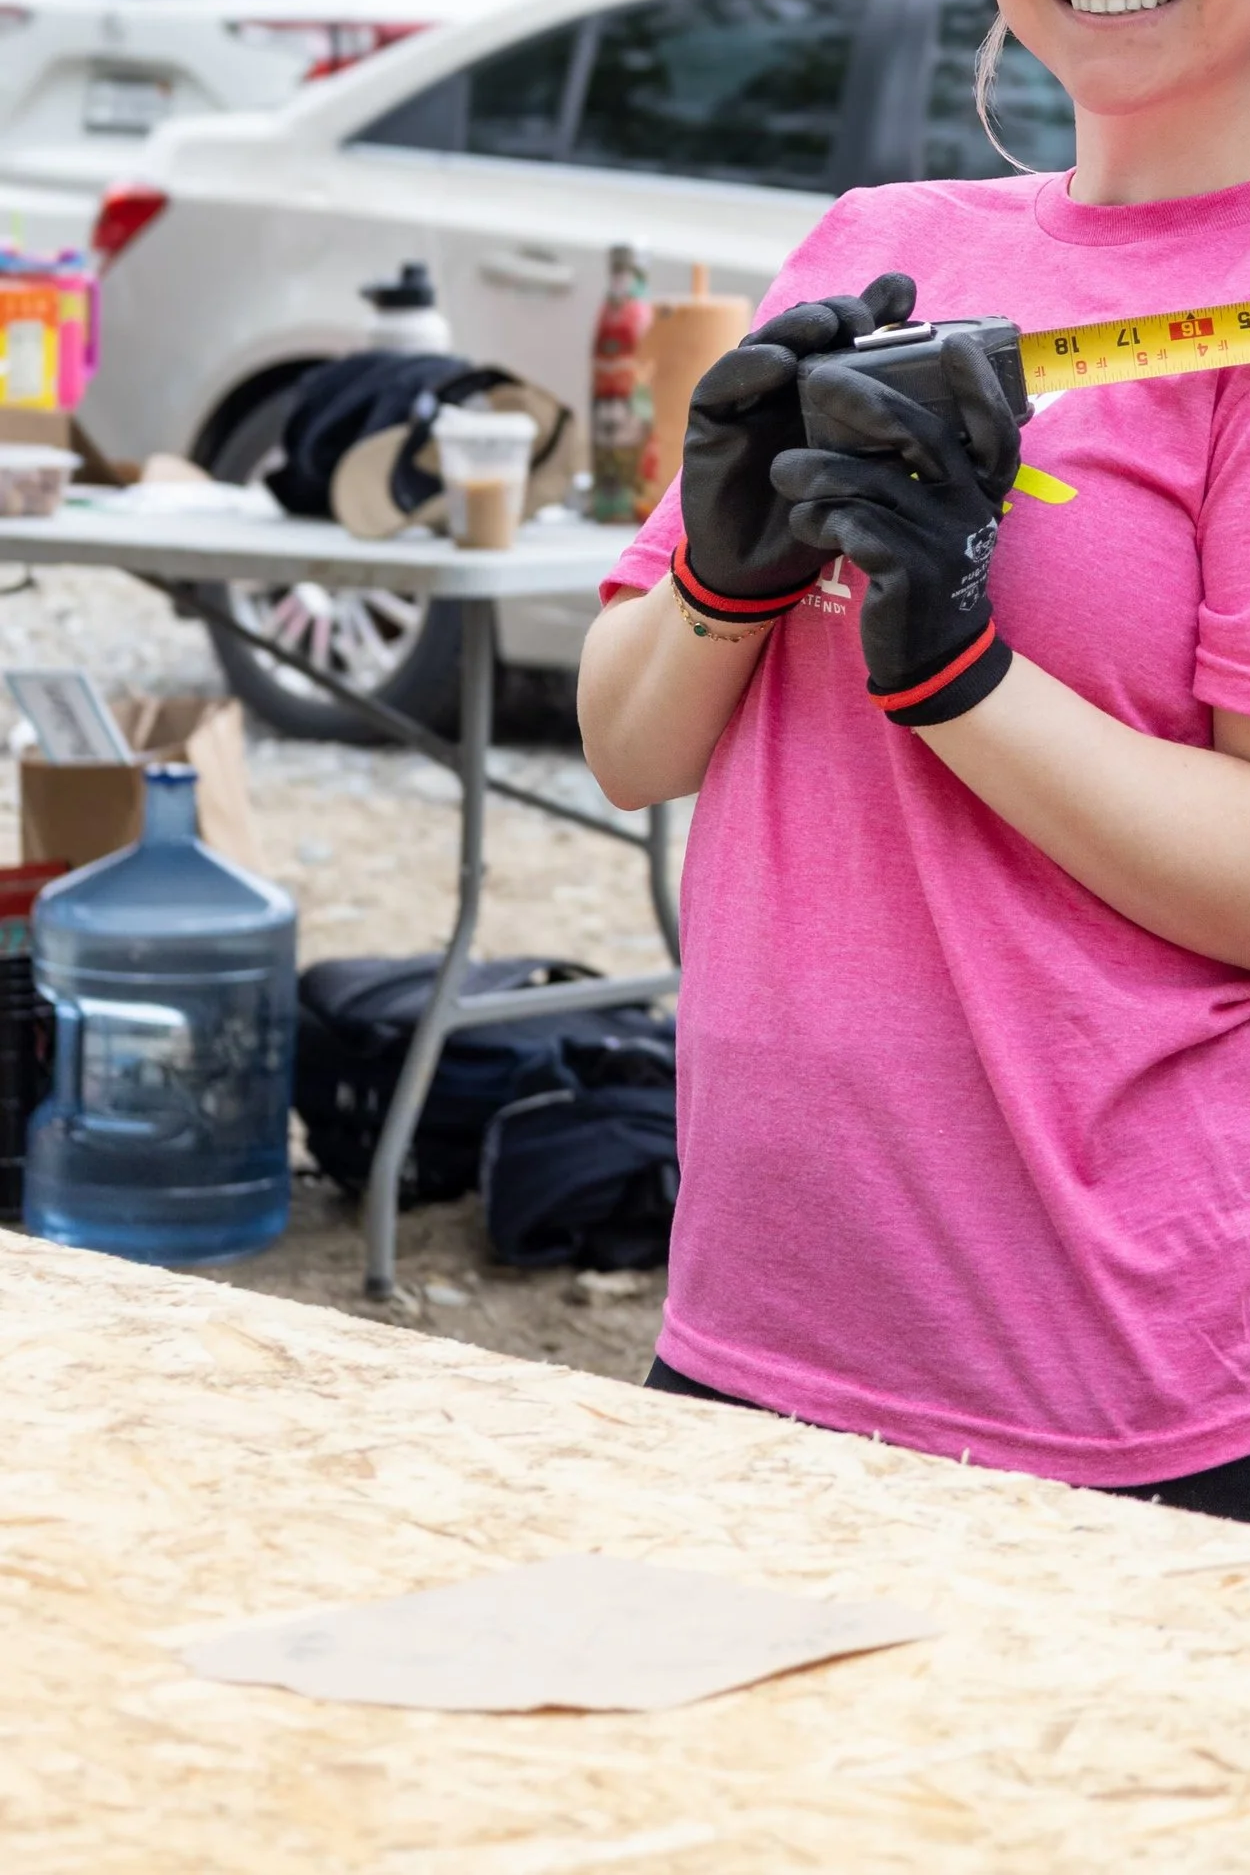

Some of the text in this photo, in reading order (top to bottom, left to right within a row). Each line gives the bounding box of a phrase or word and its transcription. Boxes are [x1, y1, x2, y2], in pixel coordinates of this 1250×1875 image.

[1181, 320, 1202, 337] 16
[1117, 327, 1140, 347] 17
[1054, 336, 1080, 355] 18
[1197, 343, 1208, 357] 4
[1136, 351, 1148, 366] 5
[1075, 360, 1087, 375] 6
